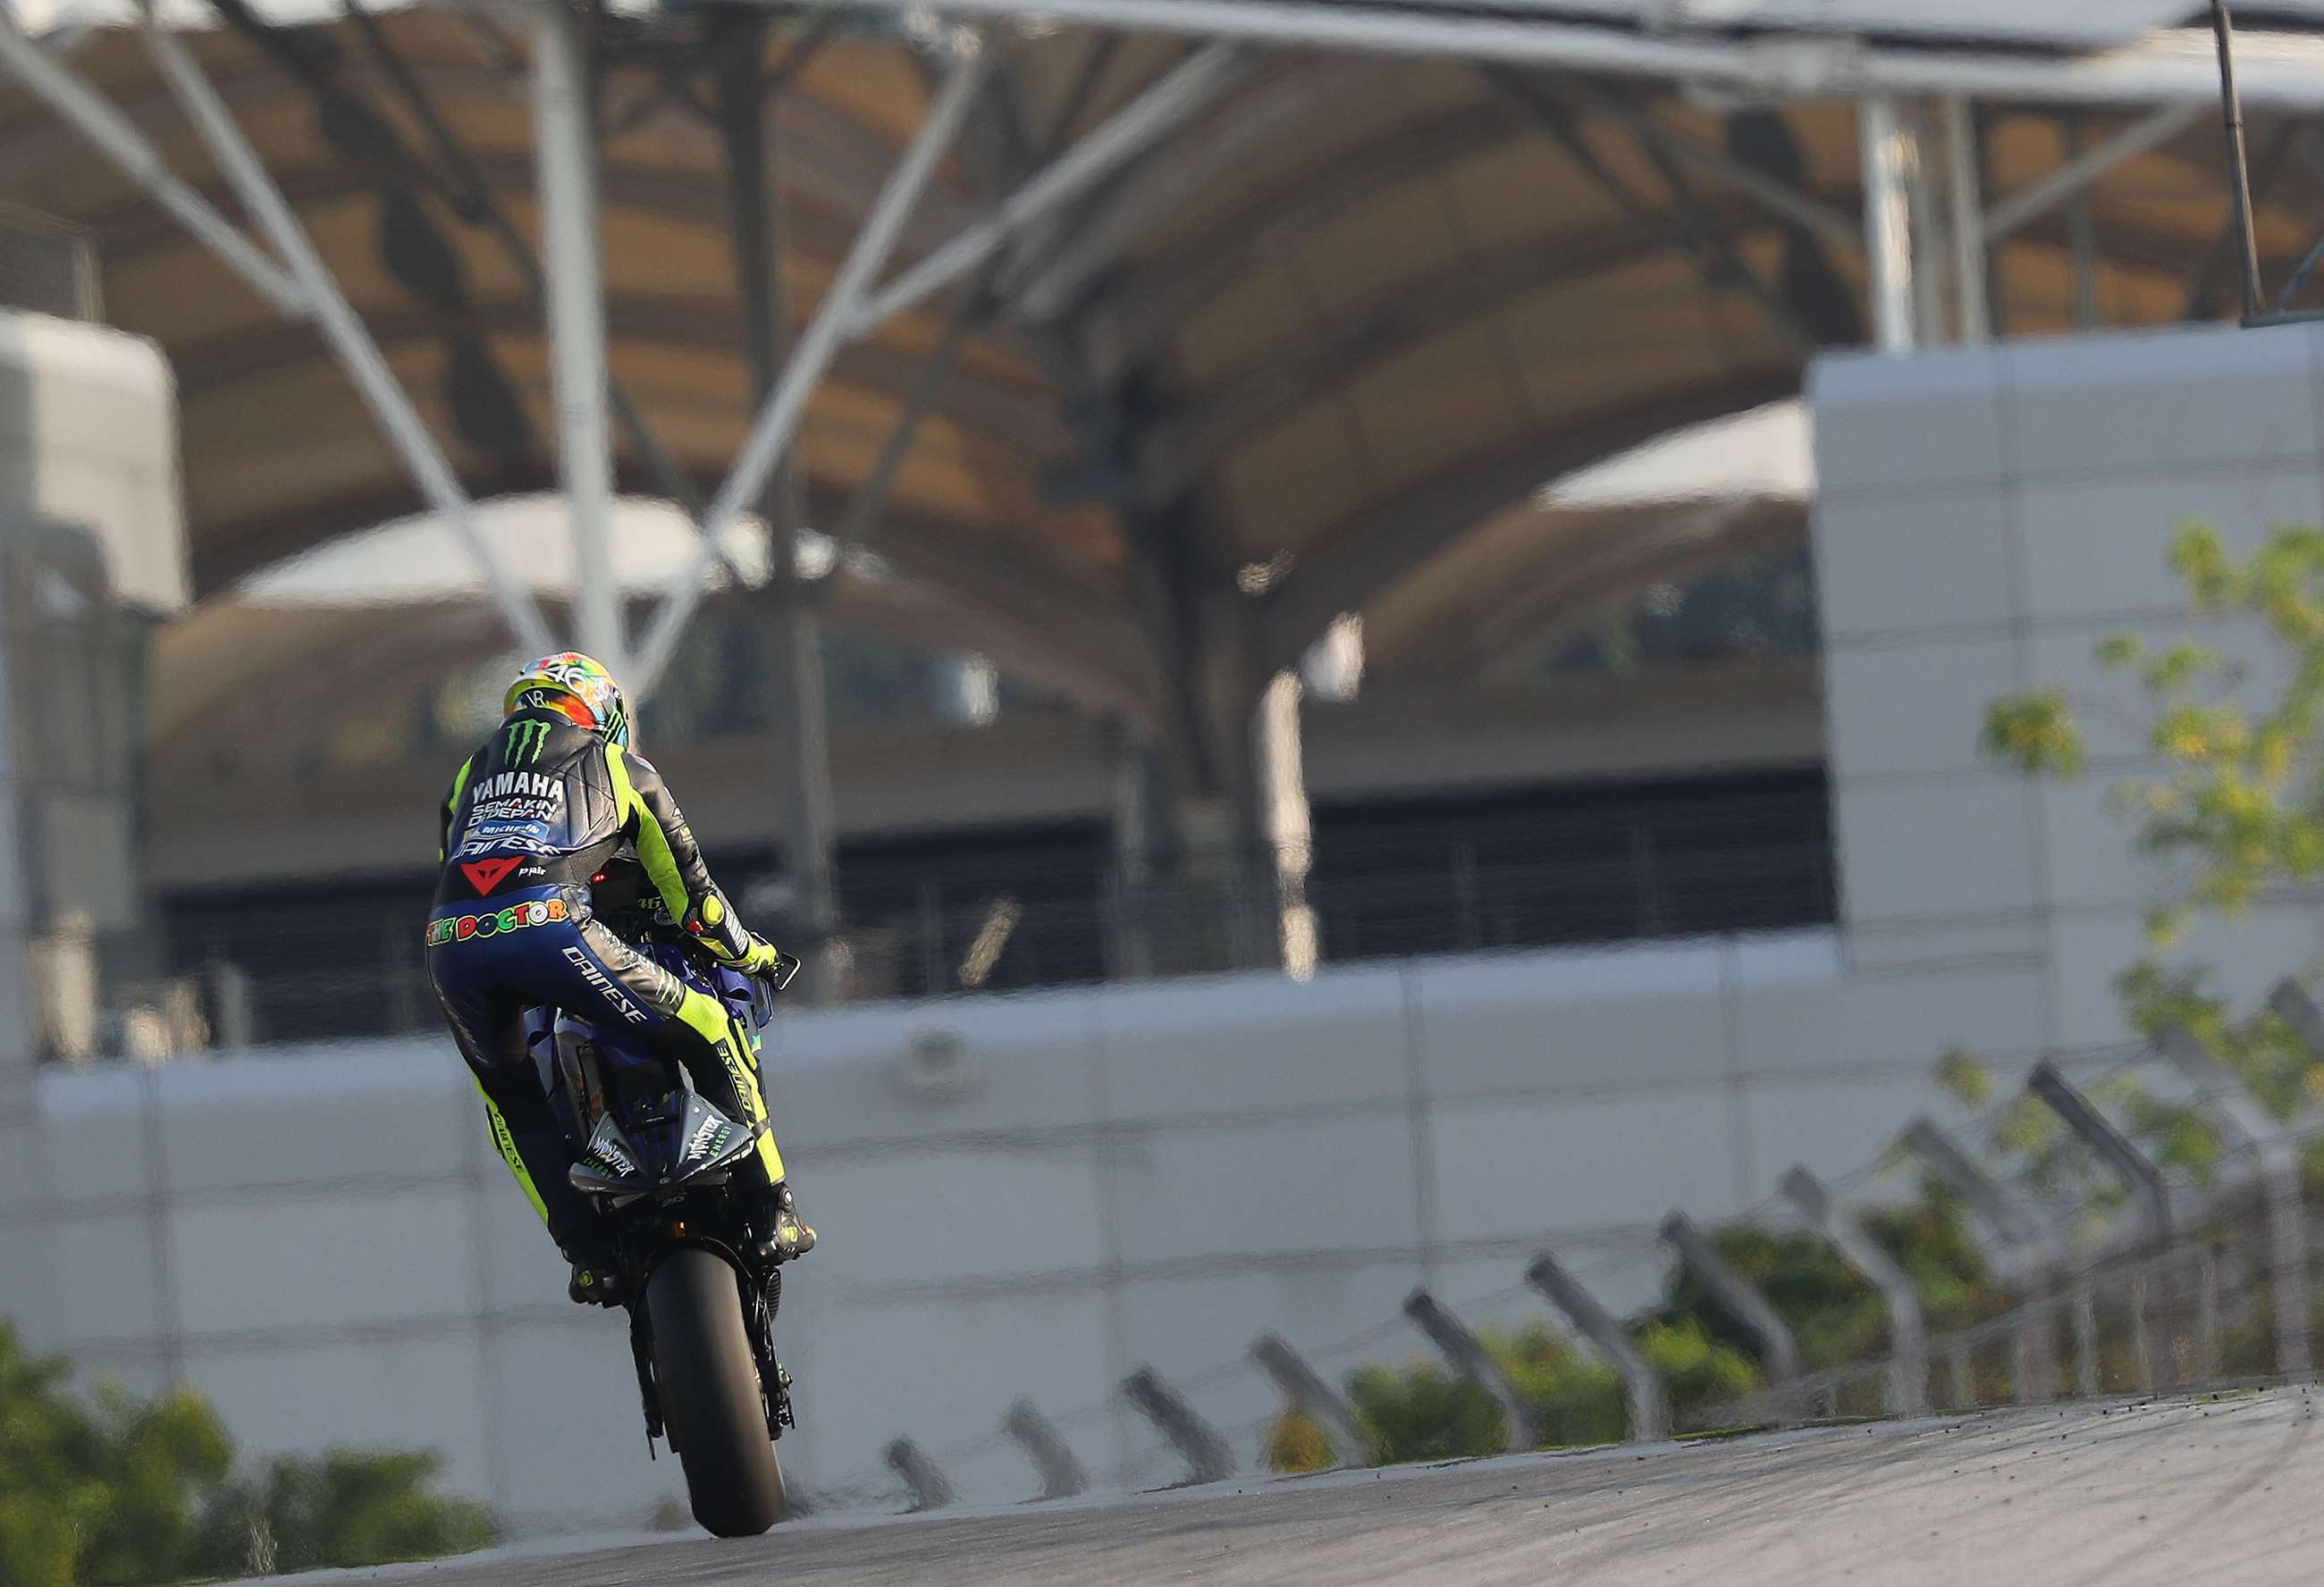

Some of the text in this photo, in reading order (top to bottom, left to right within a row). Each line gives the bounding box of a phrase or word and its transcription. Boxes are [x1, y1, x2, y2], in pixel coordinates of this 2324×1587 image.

[526, 690, 547, 708] VR
[543, 664, 587, 694] 46
[472, 771, 565, 804] YAMAHA
[426, 898, 570, 946] THE DOCTOR
[562, 946, 648, 1024] DAINESE
[686, 1113, 724, 1161] MONSTER
